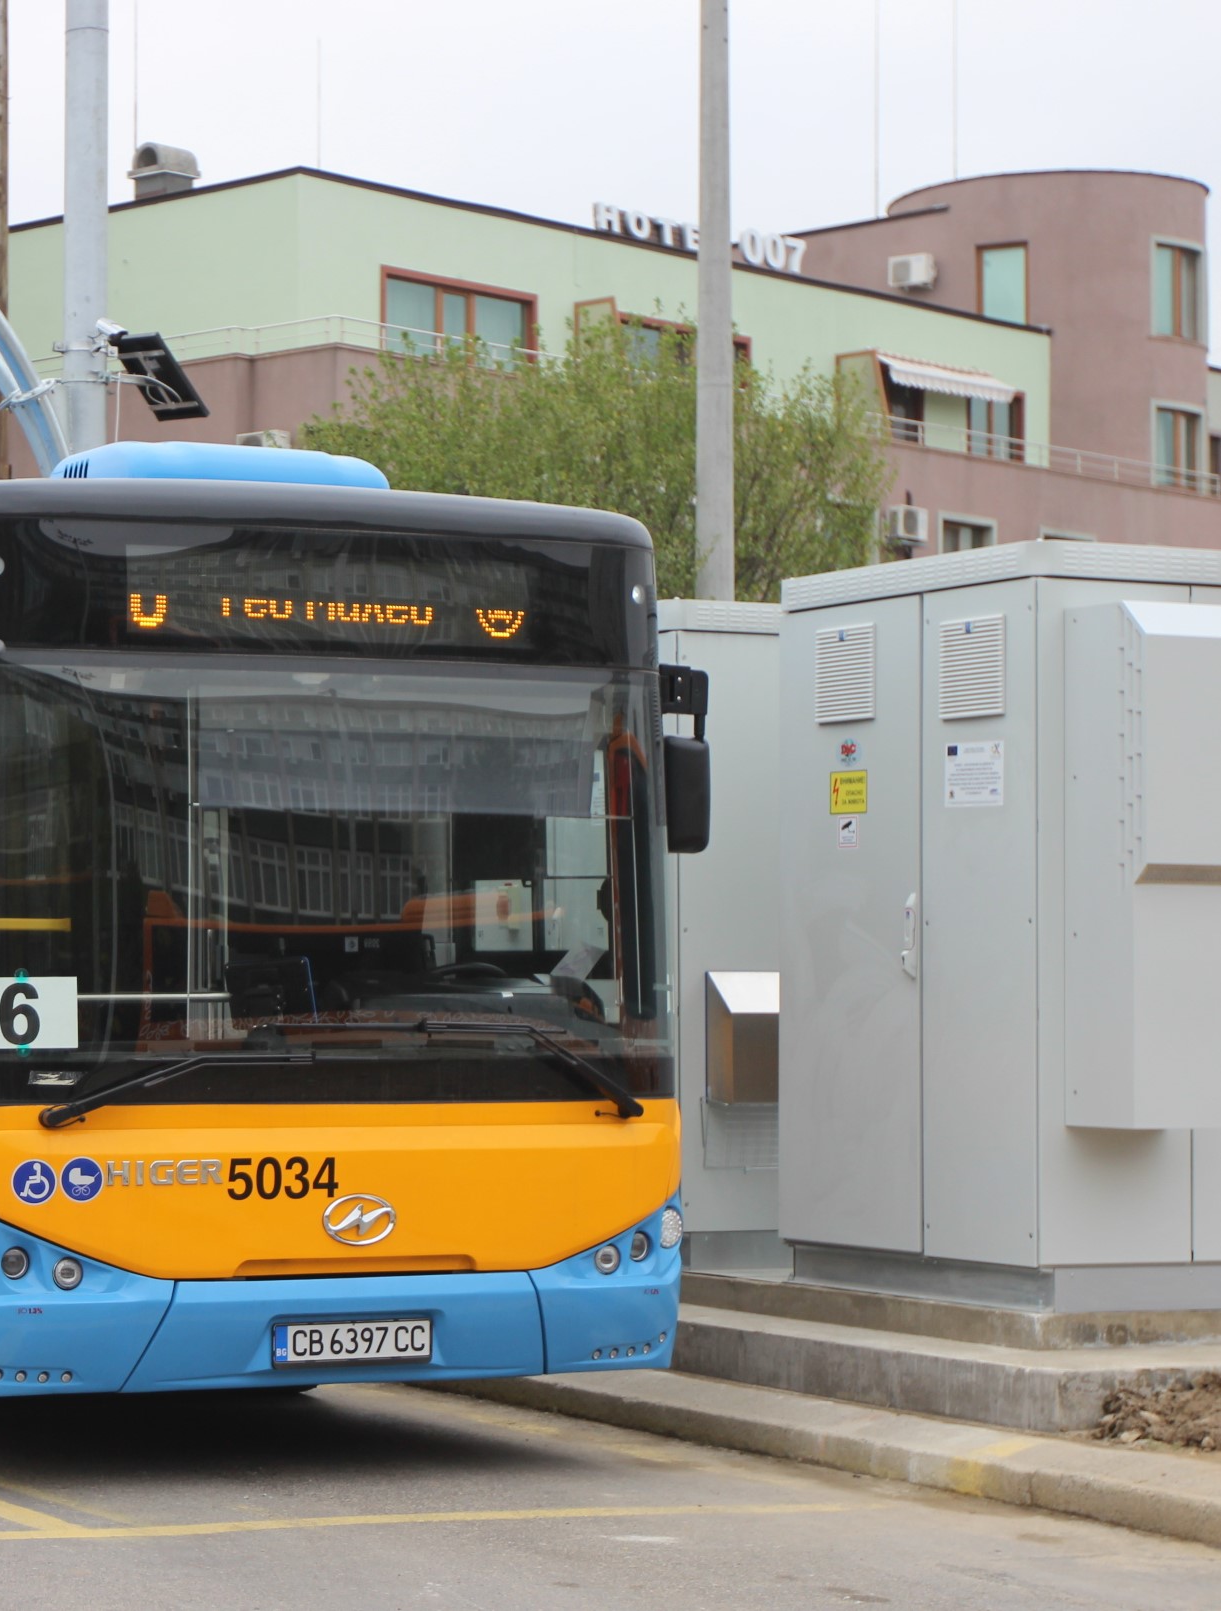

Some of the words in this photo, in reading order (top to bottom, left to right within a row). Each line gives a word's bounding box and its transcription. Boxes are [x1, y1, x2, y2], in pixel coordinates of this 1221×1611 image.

[593, 201, 700, 250] HOTE
[740, 227, 807, 275] 007
[105, 1158, 224, 1187] HIGER
[226, 1156, 340, 1201] 5034
[275, 1348, 287, 1357] BG
[292, 1329, 325, 1357] CB
[330, 1326, 390, 1354] 6397
[394, 1324, 427, 1352] CC
